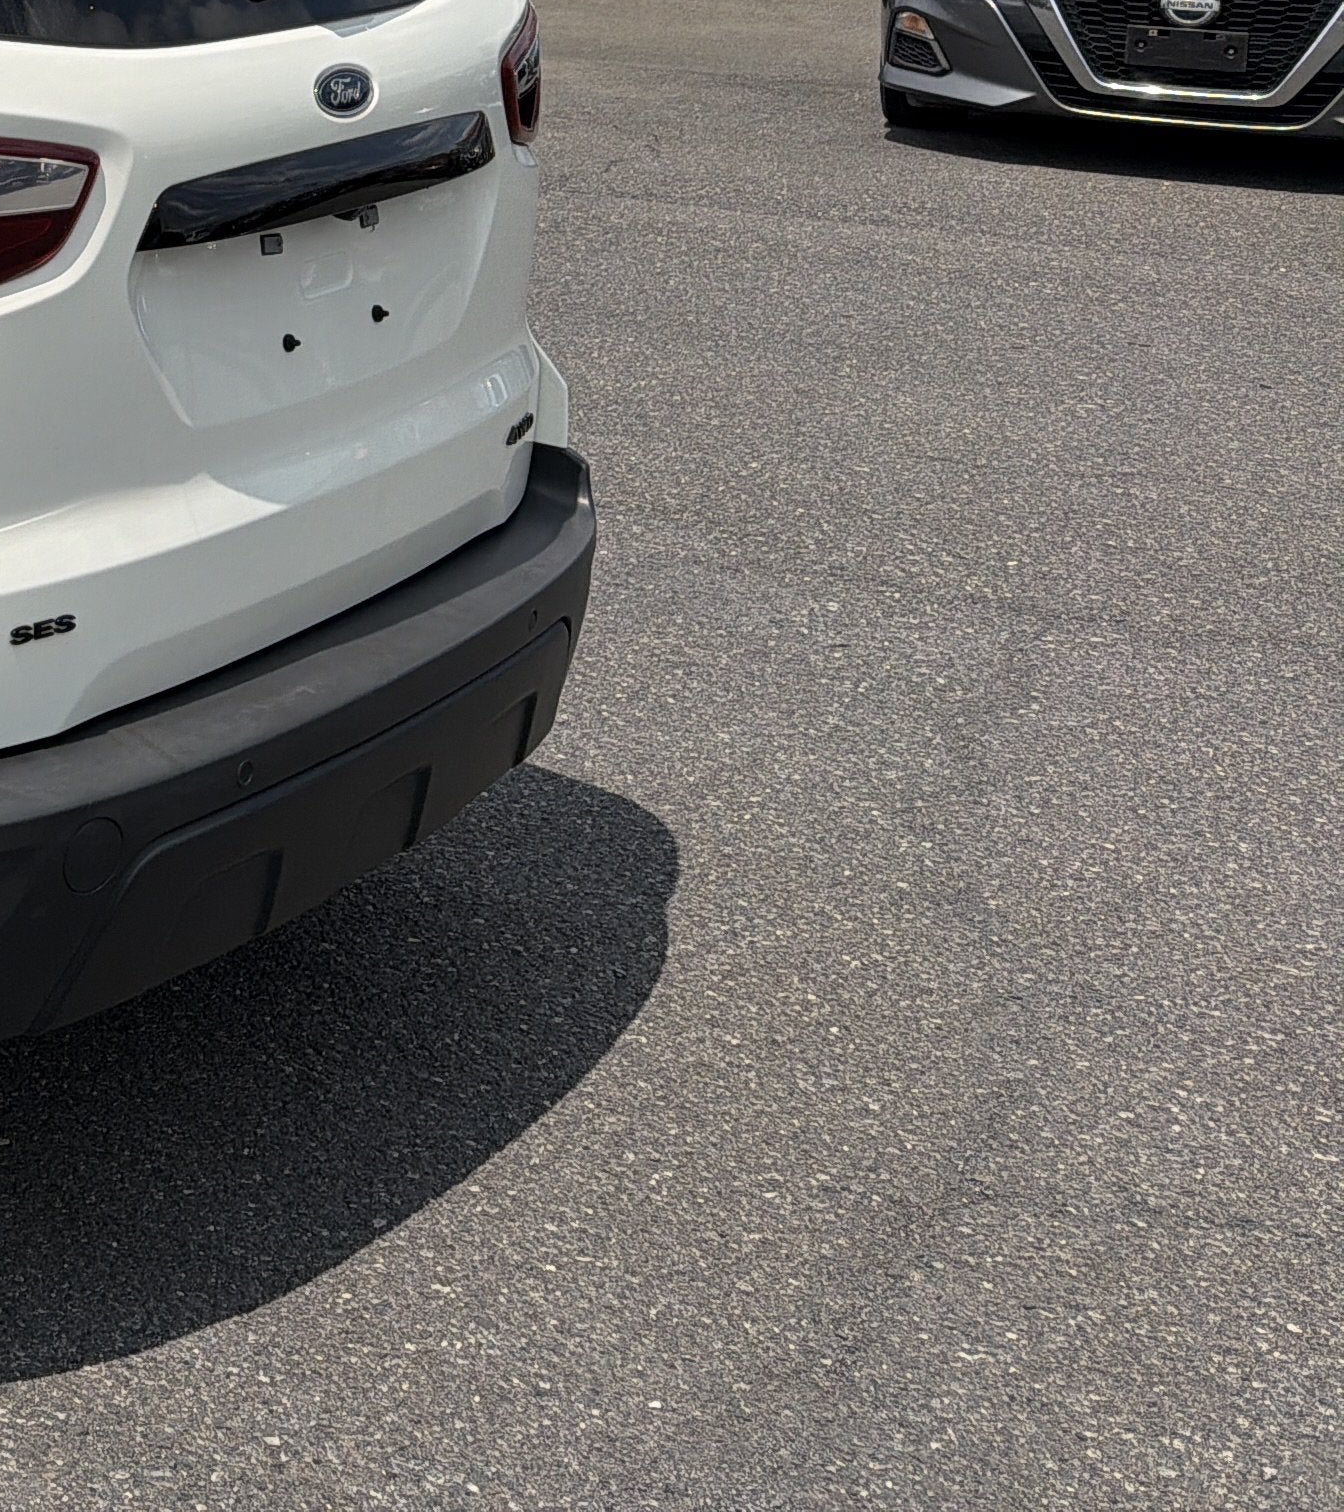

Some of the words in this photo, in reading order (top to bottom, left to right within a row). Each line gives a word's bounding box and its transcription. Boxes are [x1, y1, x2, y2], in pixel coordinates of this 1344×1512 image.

[1166, 0, 1214, 9] NISSAN
[330, 76, 361, 107] Ford
[9, 614, 77, 646] SES
